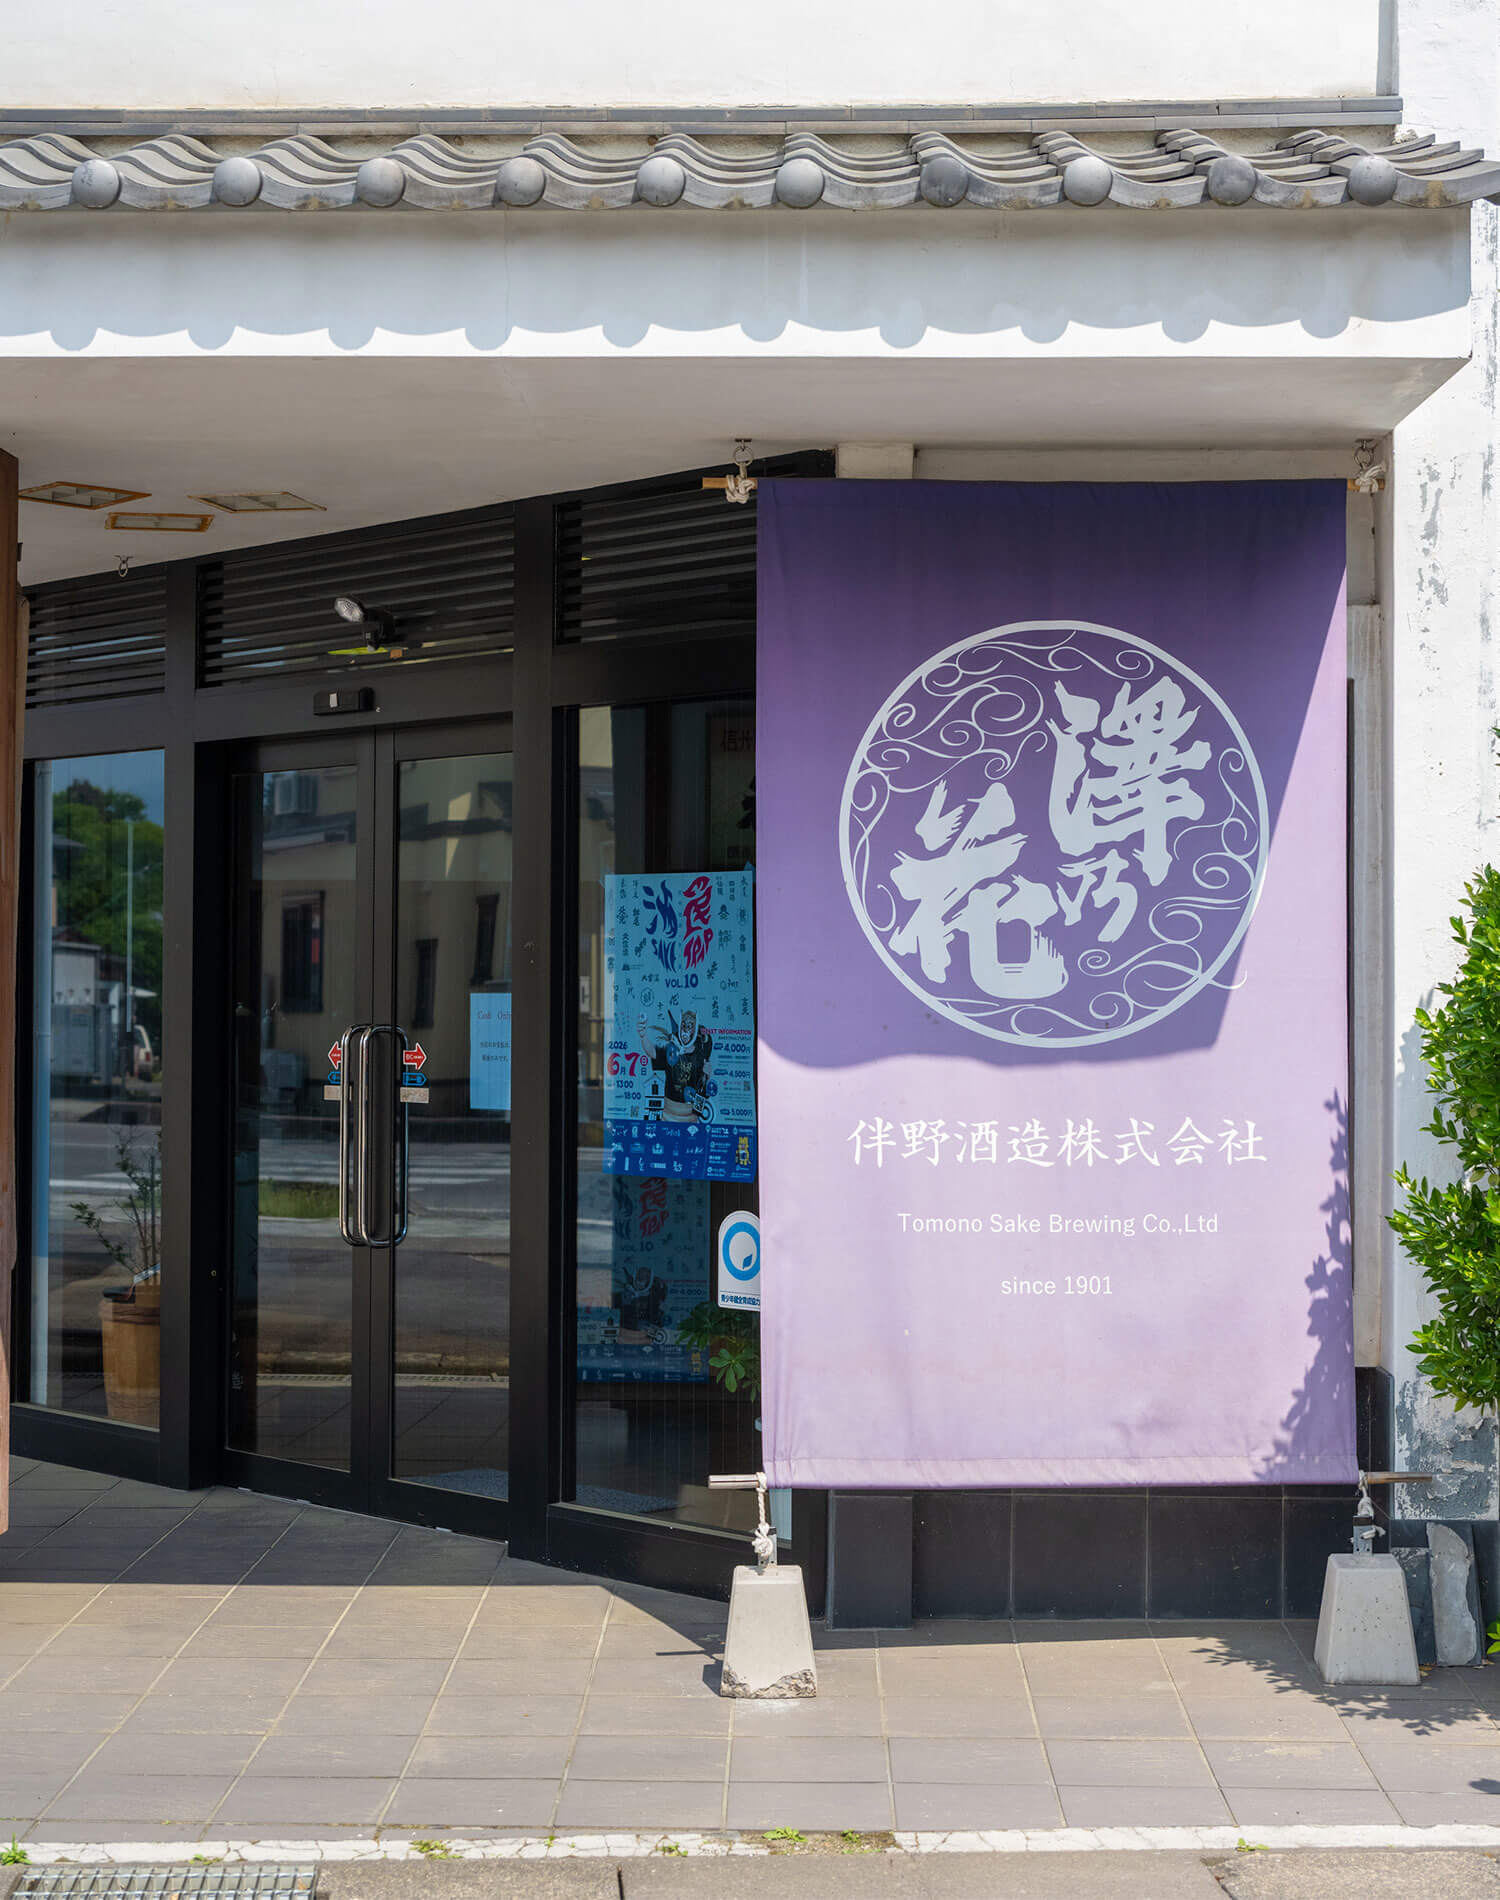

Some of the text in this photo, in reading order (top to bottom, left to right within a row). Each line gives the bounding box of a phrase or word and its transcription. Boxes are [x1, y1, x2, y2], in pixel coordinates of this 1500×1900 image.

[846, 1116, 1268, 1168] 伴野酒造株式会社
[898, 1213, 1220, 1238] Tomono Sake Brewing Co.,Ltd
[1000, 1275, 1114, 1295] since 1901
